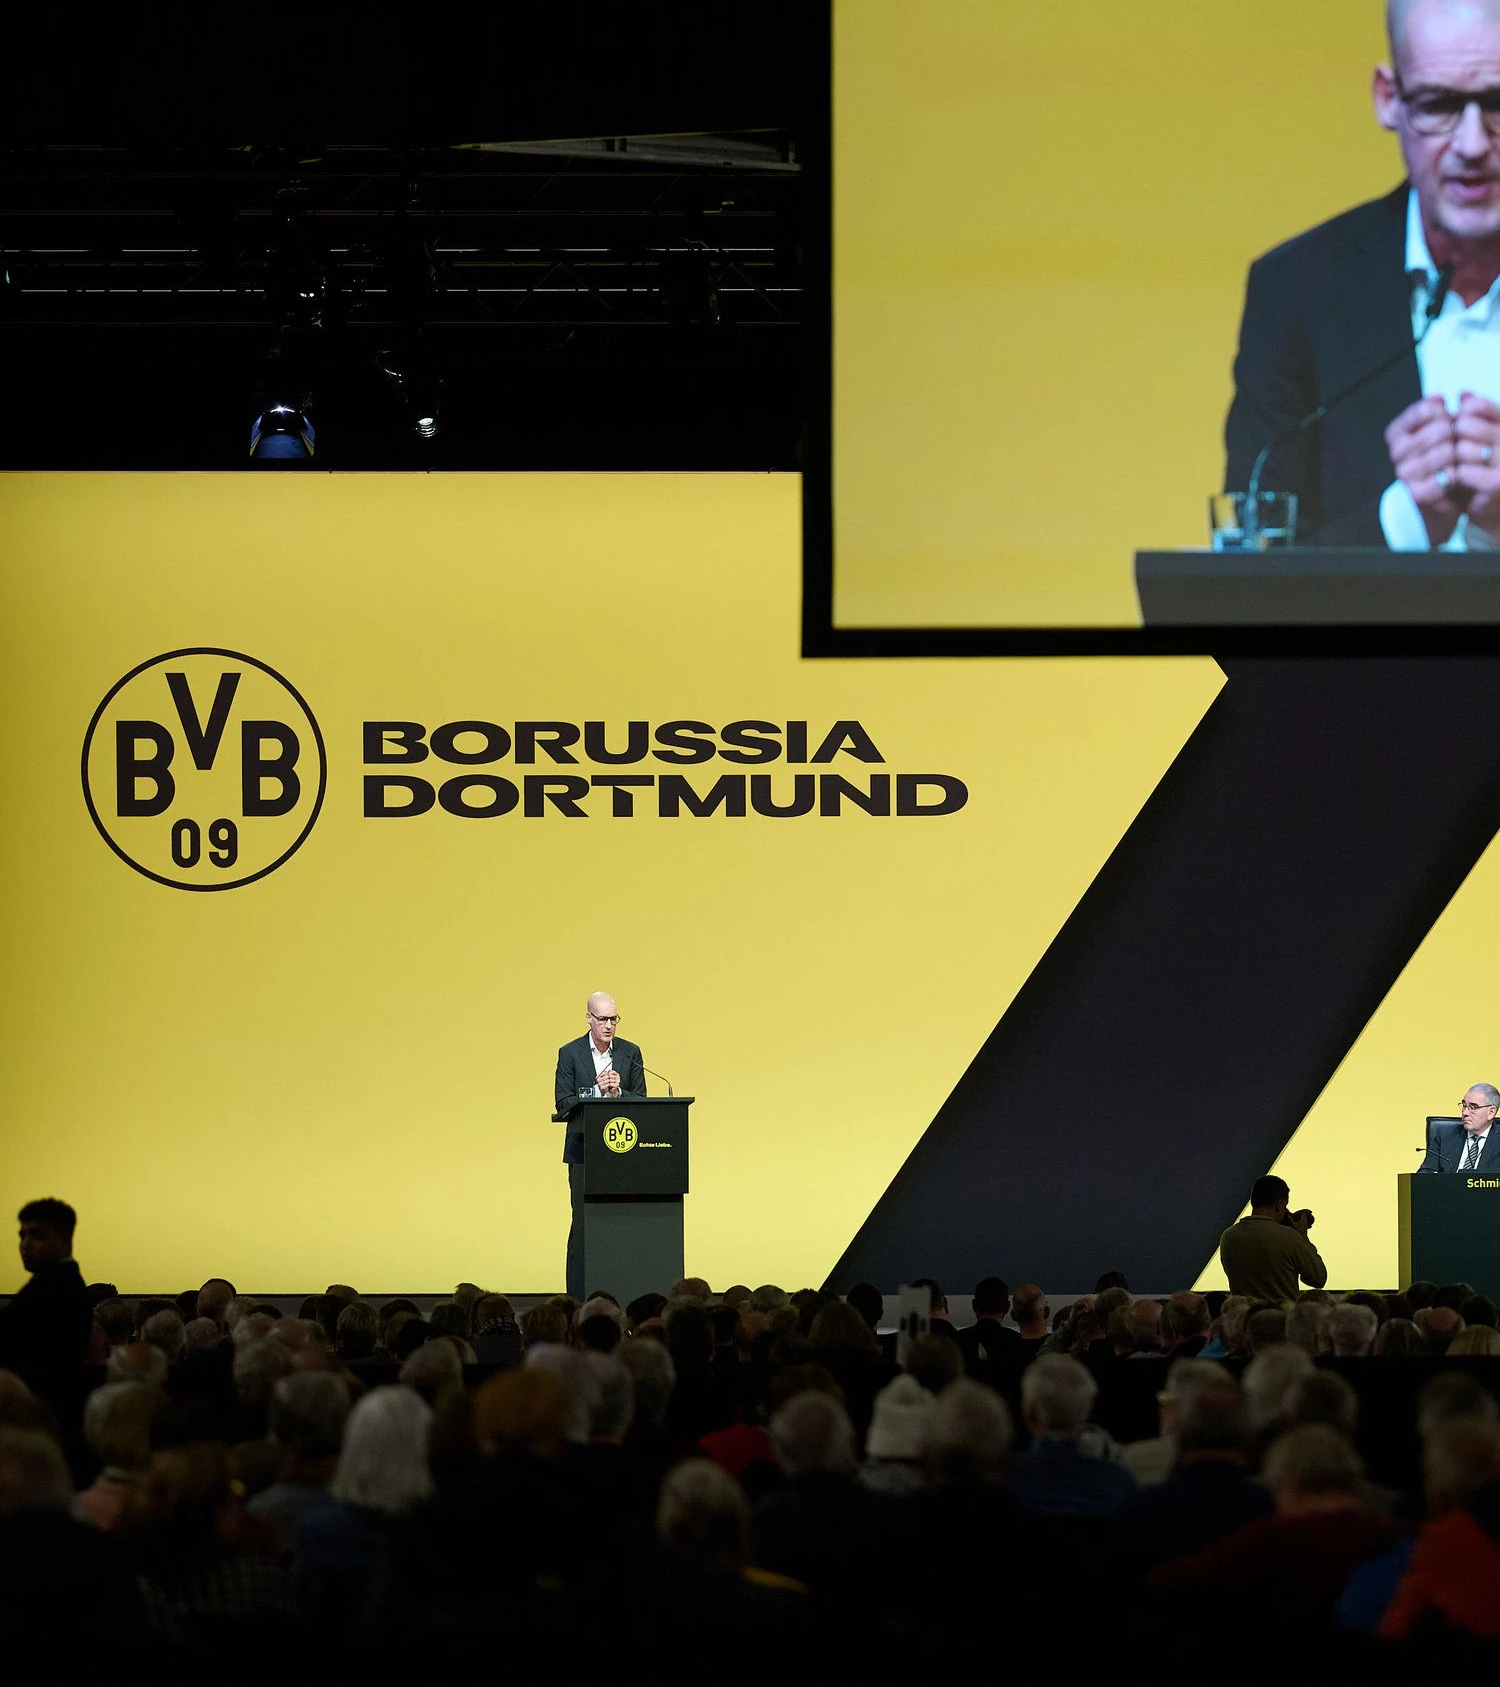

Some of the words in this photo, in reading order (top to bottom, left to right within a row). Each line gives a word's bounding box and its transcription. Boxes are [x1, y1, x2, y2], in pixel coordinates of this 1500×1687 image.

[115, 672, 301, 817] BVB
[363, 719, 886, 765] BORUSSIA
[363, 773, 969, 819] DORTMUND
[171, 818, 239, 869] 09
[609, 1121, 634, 1142] BVB
